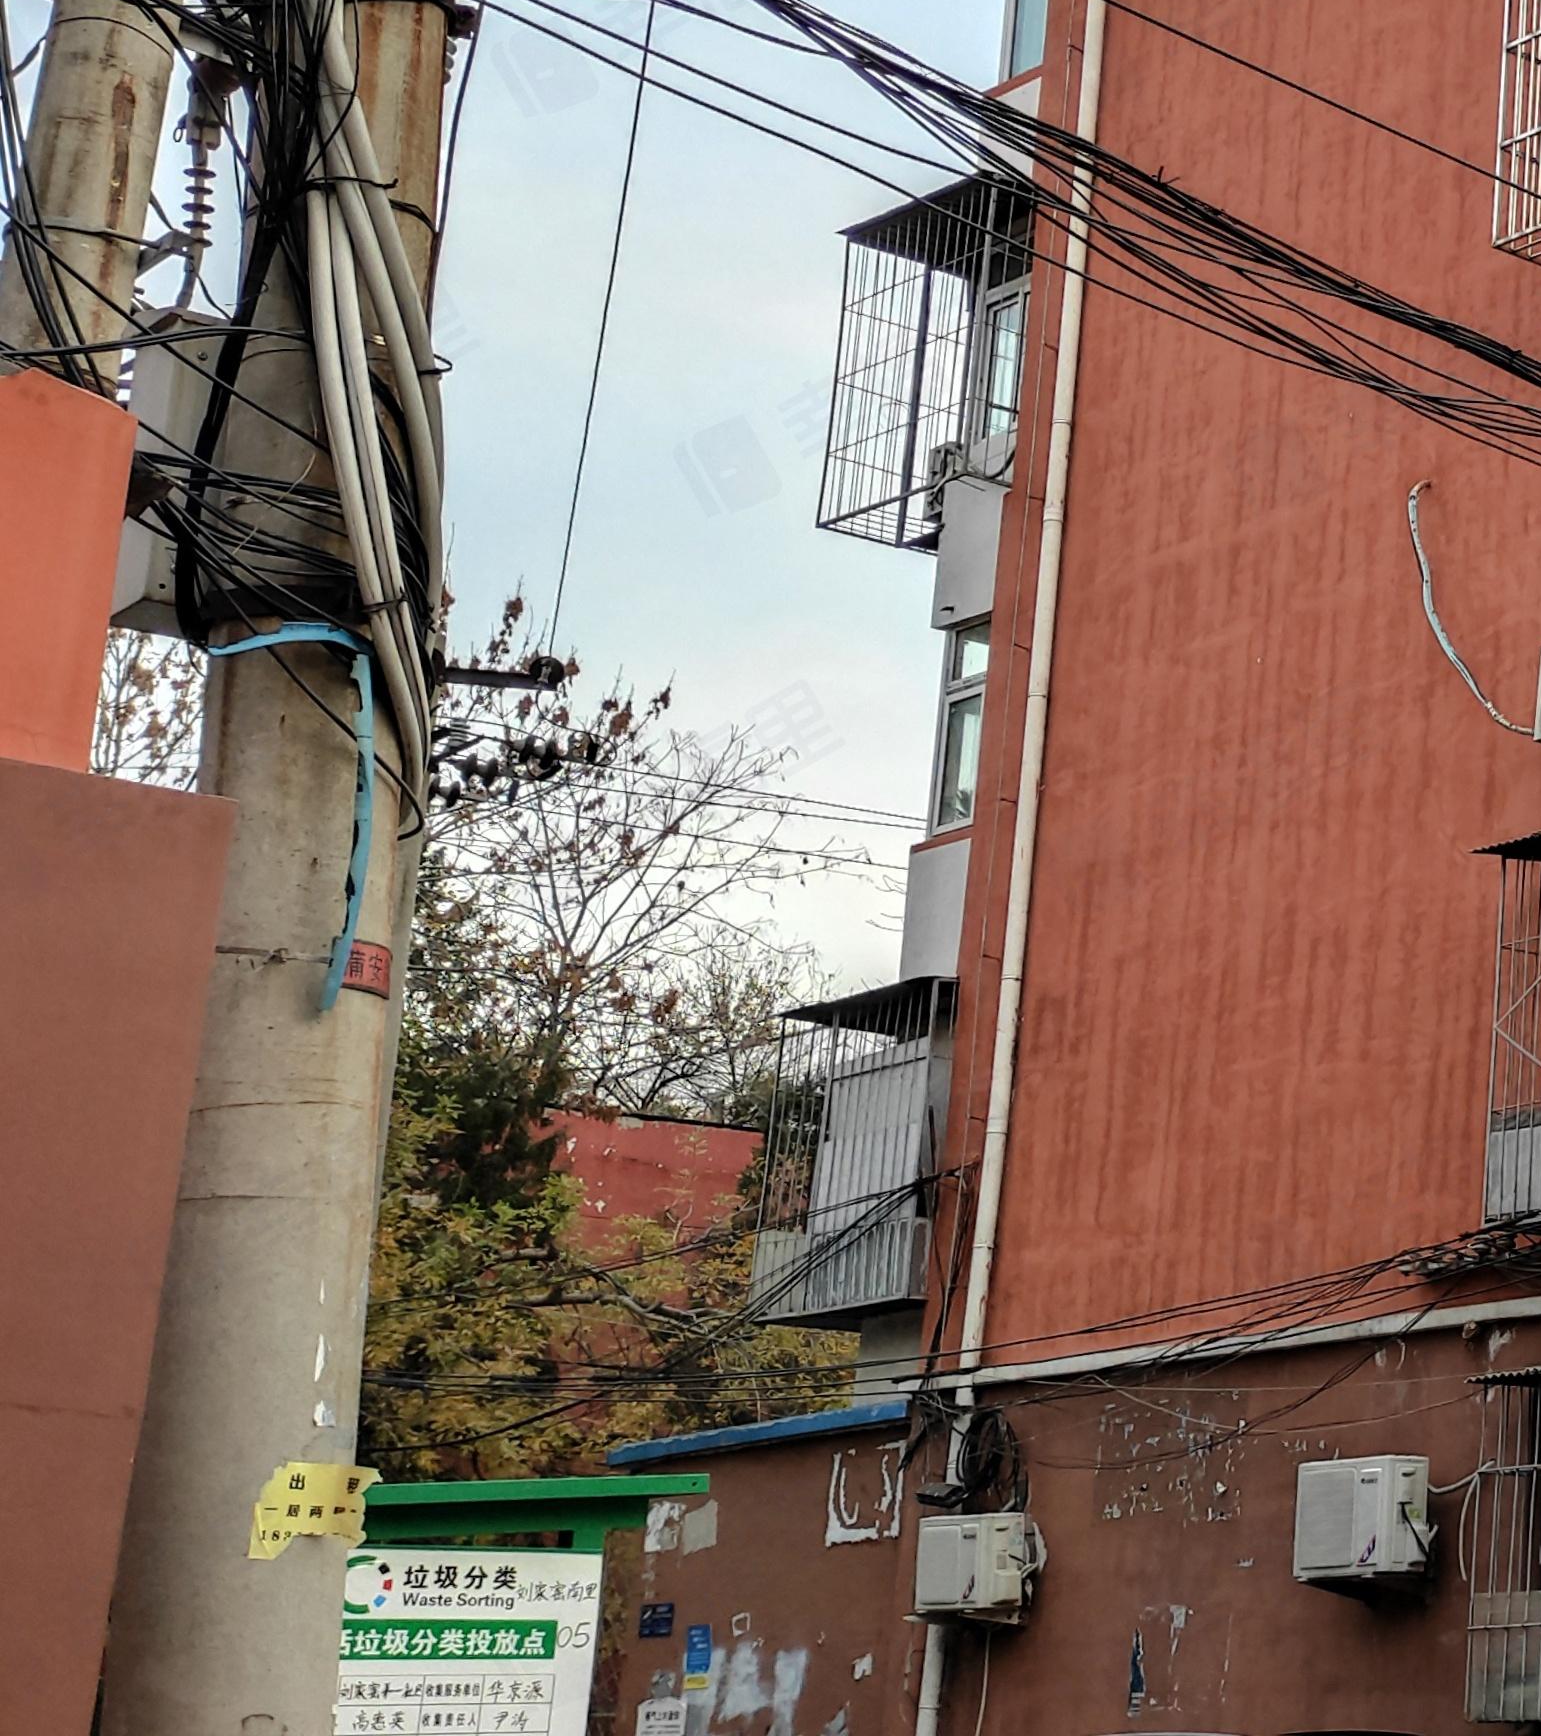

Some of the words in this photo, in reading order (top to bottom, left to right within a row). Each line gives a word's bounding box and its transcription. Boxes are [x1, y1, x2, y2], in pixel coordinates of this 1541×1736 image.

[402, 1564, 518, 1592] 垃圾分类
[402, 1593, 453, 1609] Waste
[456, 1592, 516, 1612] Sorting
[556, 1621, 592, 1650] 05
